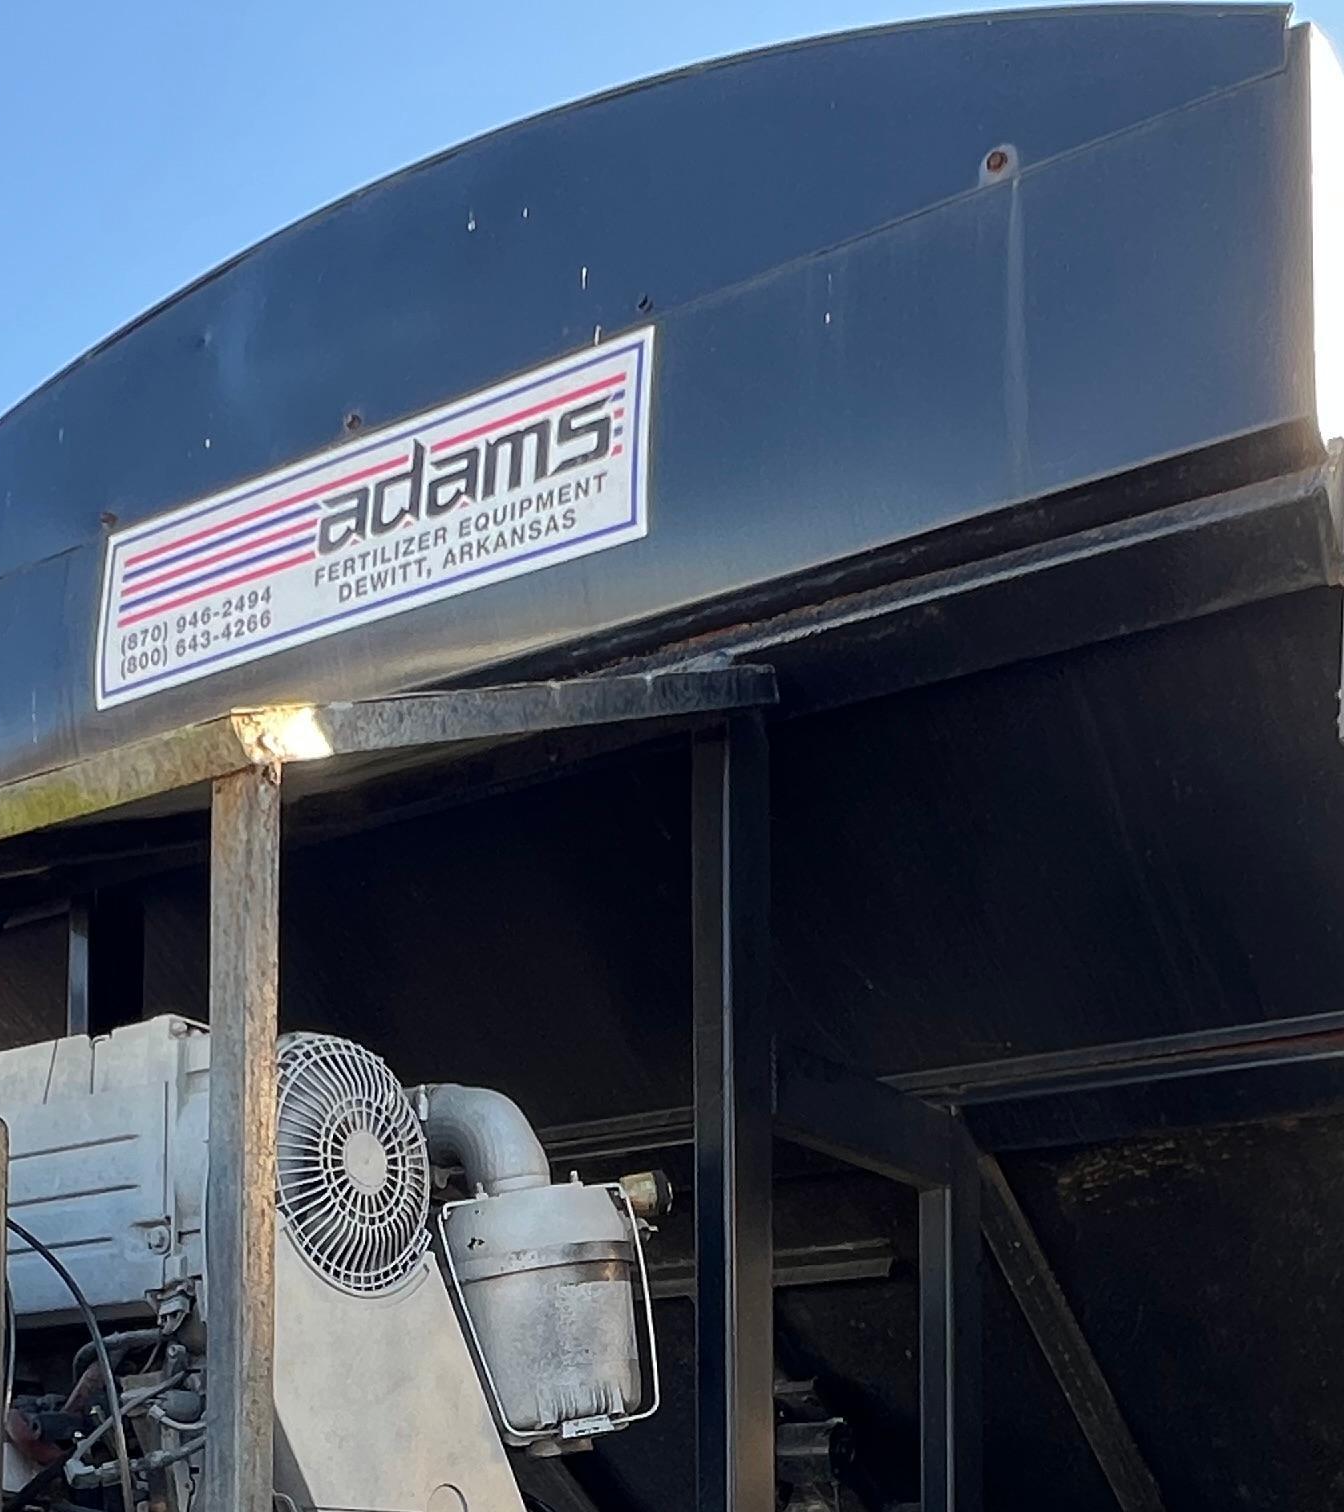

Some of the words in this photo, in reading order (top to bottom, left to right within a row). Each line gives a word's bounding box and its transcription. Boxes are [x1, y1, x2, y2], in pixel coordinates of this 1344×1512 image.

[318, 396, 613, 556] adams
[313, 526, 448, 588] FERTILIZER
[458, 471, 608, 539] EQUIPMENT
[338, 556, 433, 604] DEWITT,
[442, 508, 577, 570] ARKANSAS
[120, 621, 168, 657] (870)
[175, 585, 272, 634] 946-2494
[120, 644, 168, 680] (800)
[175, 609, 272, 658] 643-4266
